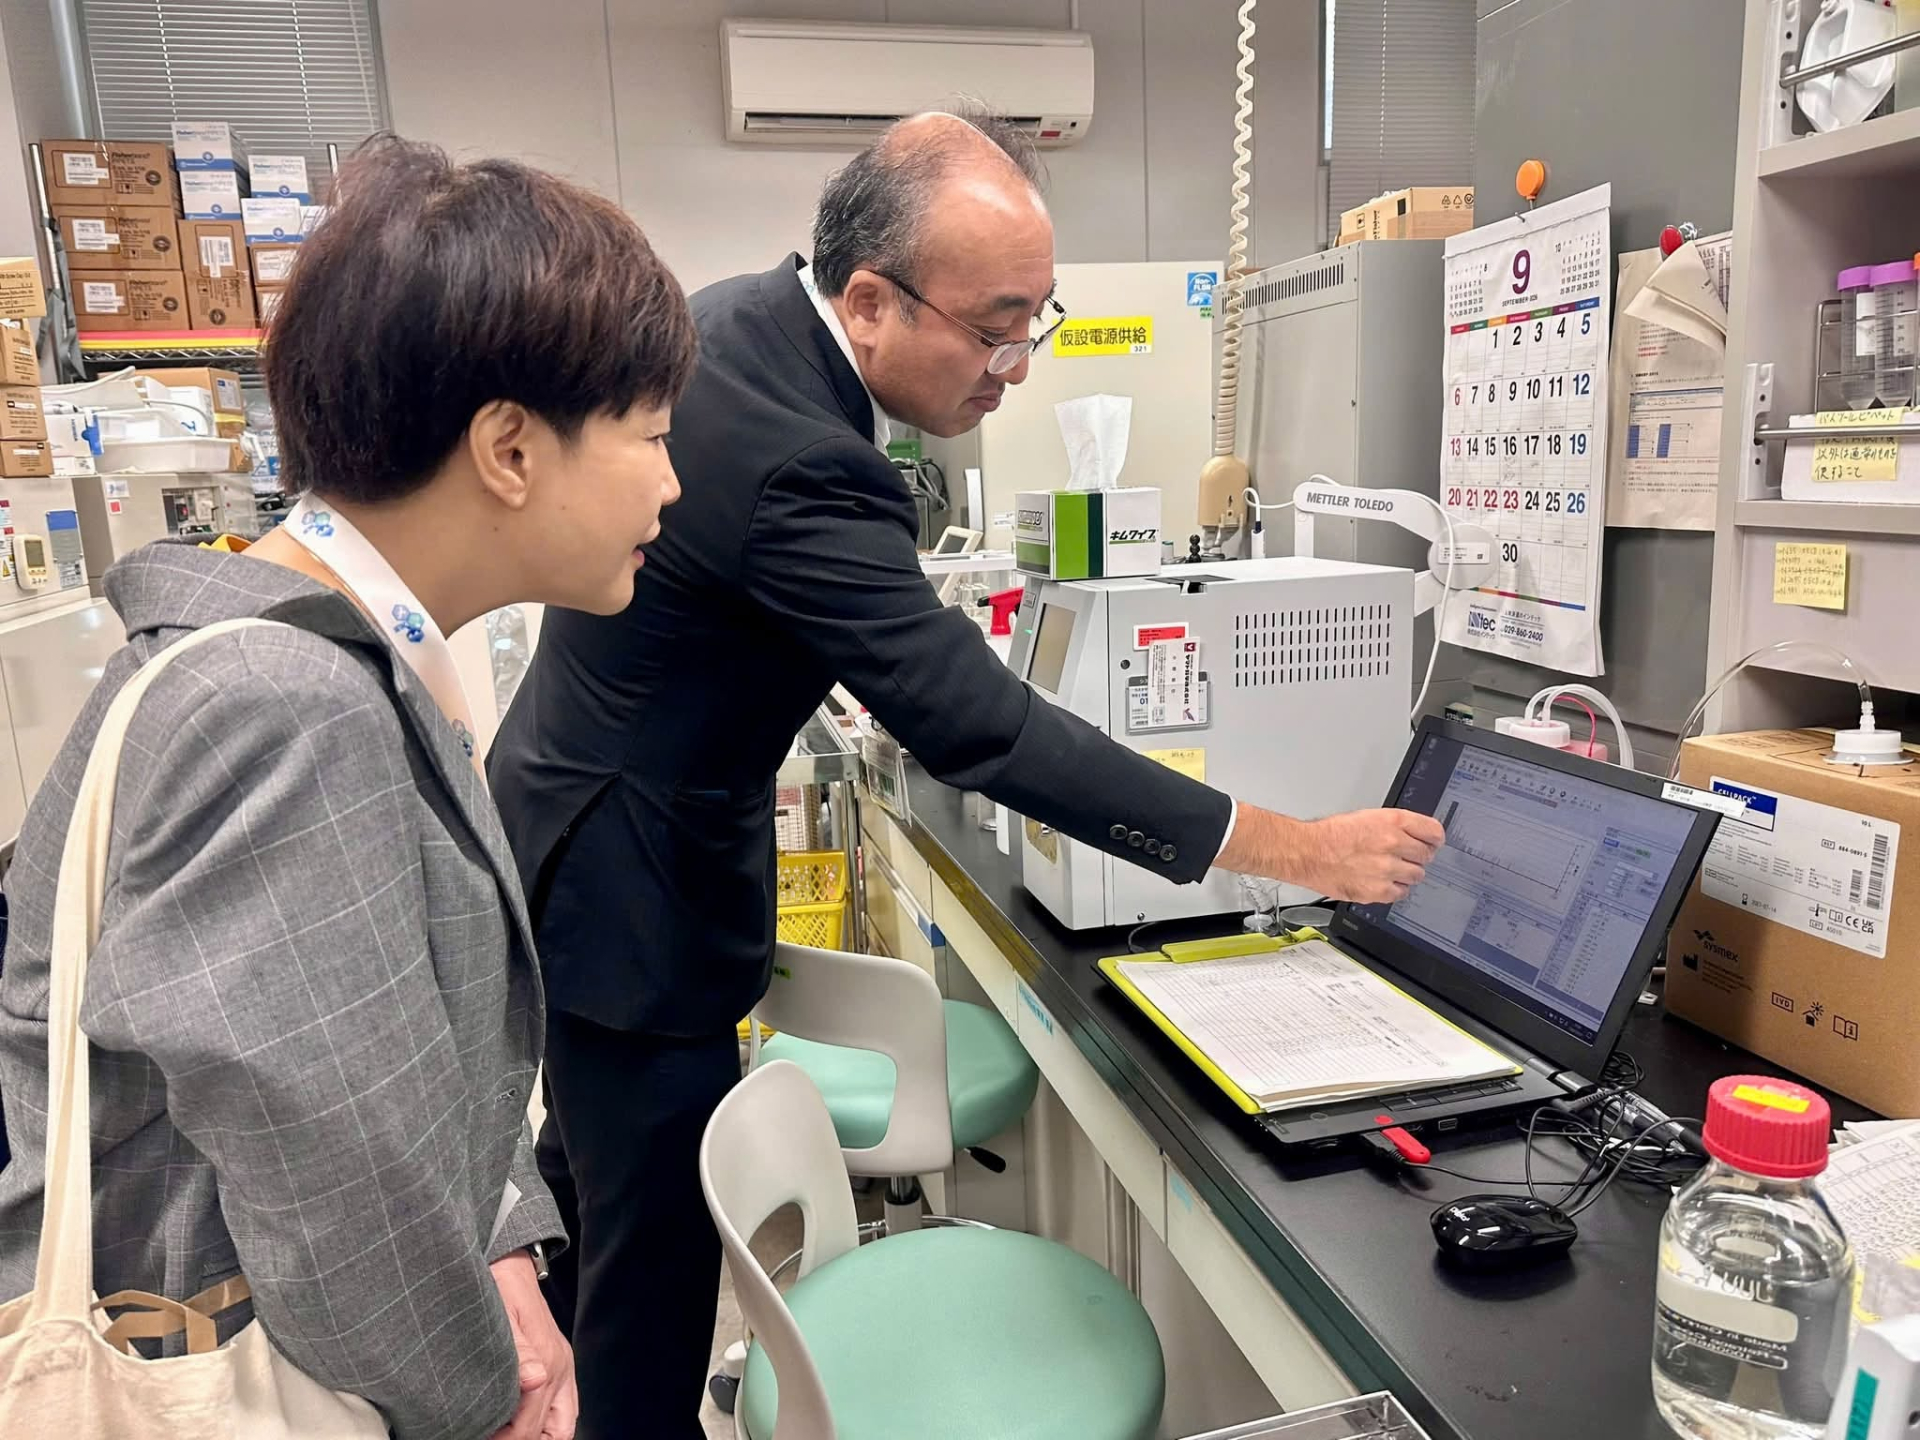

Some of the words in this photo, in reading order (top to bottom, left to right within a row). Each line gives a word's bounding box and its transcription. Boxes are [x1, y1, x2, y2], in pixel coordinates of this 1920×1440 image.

[1512, 250, 1531, 294] 9
[1502, 296, 1528, 307] SEPTEMBER
[1060, 326, 1147, 346] 仮設電源供給
[1493, 329, 1498, 348] 1
[1513, 326, 1522, 346] 2
[1534, 322, 1543, 342] 3
[1557, 317, 1566, 338] 4
[1581, 313, 1590, 335] 5
[1454, 388, 1460, 406] 6
[1472, 386, 1478, 404] 7
[1488, 384, 1495, 402] 8
[1509, 382, 1516, 401] 9
[1526, 378, 1540, 399] 10
[1549, 376, 1562, 397] 11
[1573, 374, 1590, 396] 12
[1450, 438, 1460, 456] 13
[1466, 437, 1478, 456] 14
[1484, 436, 1496, 456] 15
[1503, 436, 1516, 456] 16
[1524, 435, 1540, 455] 17
[1547, 434, 1561, 455] 18
[1570, 433, 1586, 455] 19
[1306, 492, 1350, 507] METTLER
[1354, 497, 1394, 512] TOLEDO
[1448, 488, 1460, 506] 20
[1466, 488, 1478, 506] 21
[1484, 489, 1498, 508] 22
[1504, 490, 1518, 509] 23
[1525, 490, 1540, 510] 24
[1546, 492, 1560, 512] 25
[1567, 492, 1586, 513] 26
[1502, 542, 1518, 562] 30
[1704, 940, 1738, 963] sysmex
[1776, 996, 1790, 1008] IVD
